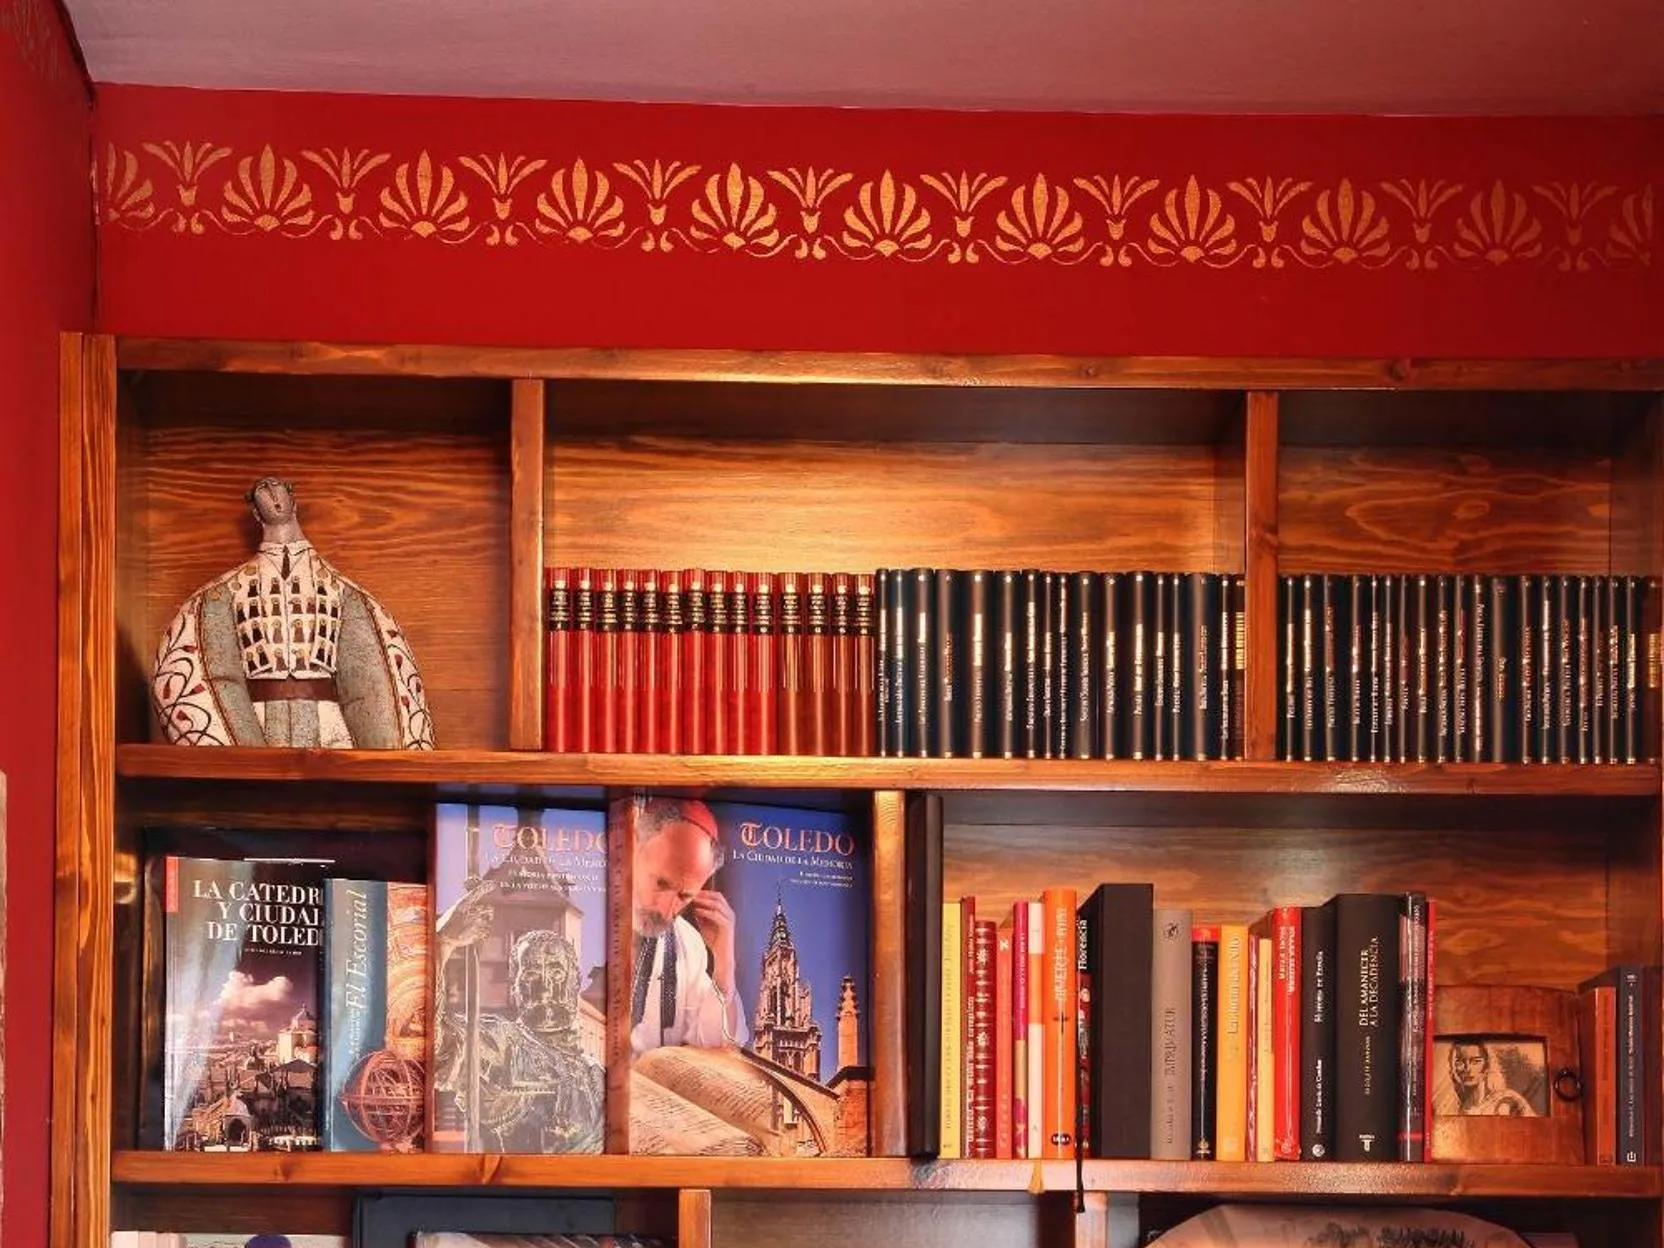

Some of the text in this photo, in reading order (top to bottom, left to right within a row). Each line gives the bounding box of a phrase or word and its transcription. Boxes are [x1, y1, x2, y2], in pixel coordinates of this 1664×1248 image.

[740, 821, 855, 856] TOLEDO
[192, 880, 320, 905] LA CATEDR
[218, 902, 232, 920] Y
[207, 921, 319, 946] DE TOLED
[346, 889, 368, 978] Escorial
[1078, 919, 1088, 970] Florencia
[346, 983, 368, 1009] El
[1359, 949, 1369, 1026] DEL AMANECER
[1369, 936, 1379, 1028] A LA DECADENCIA
